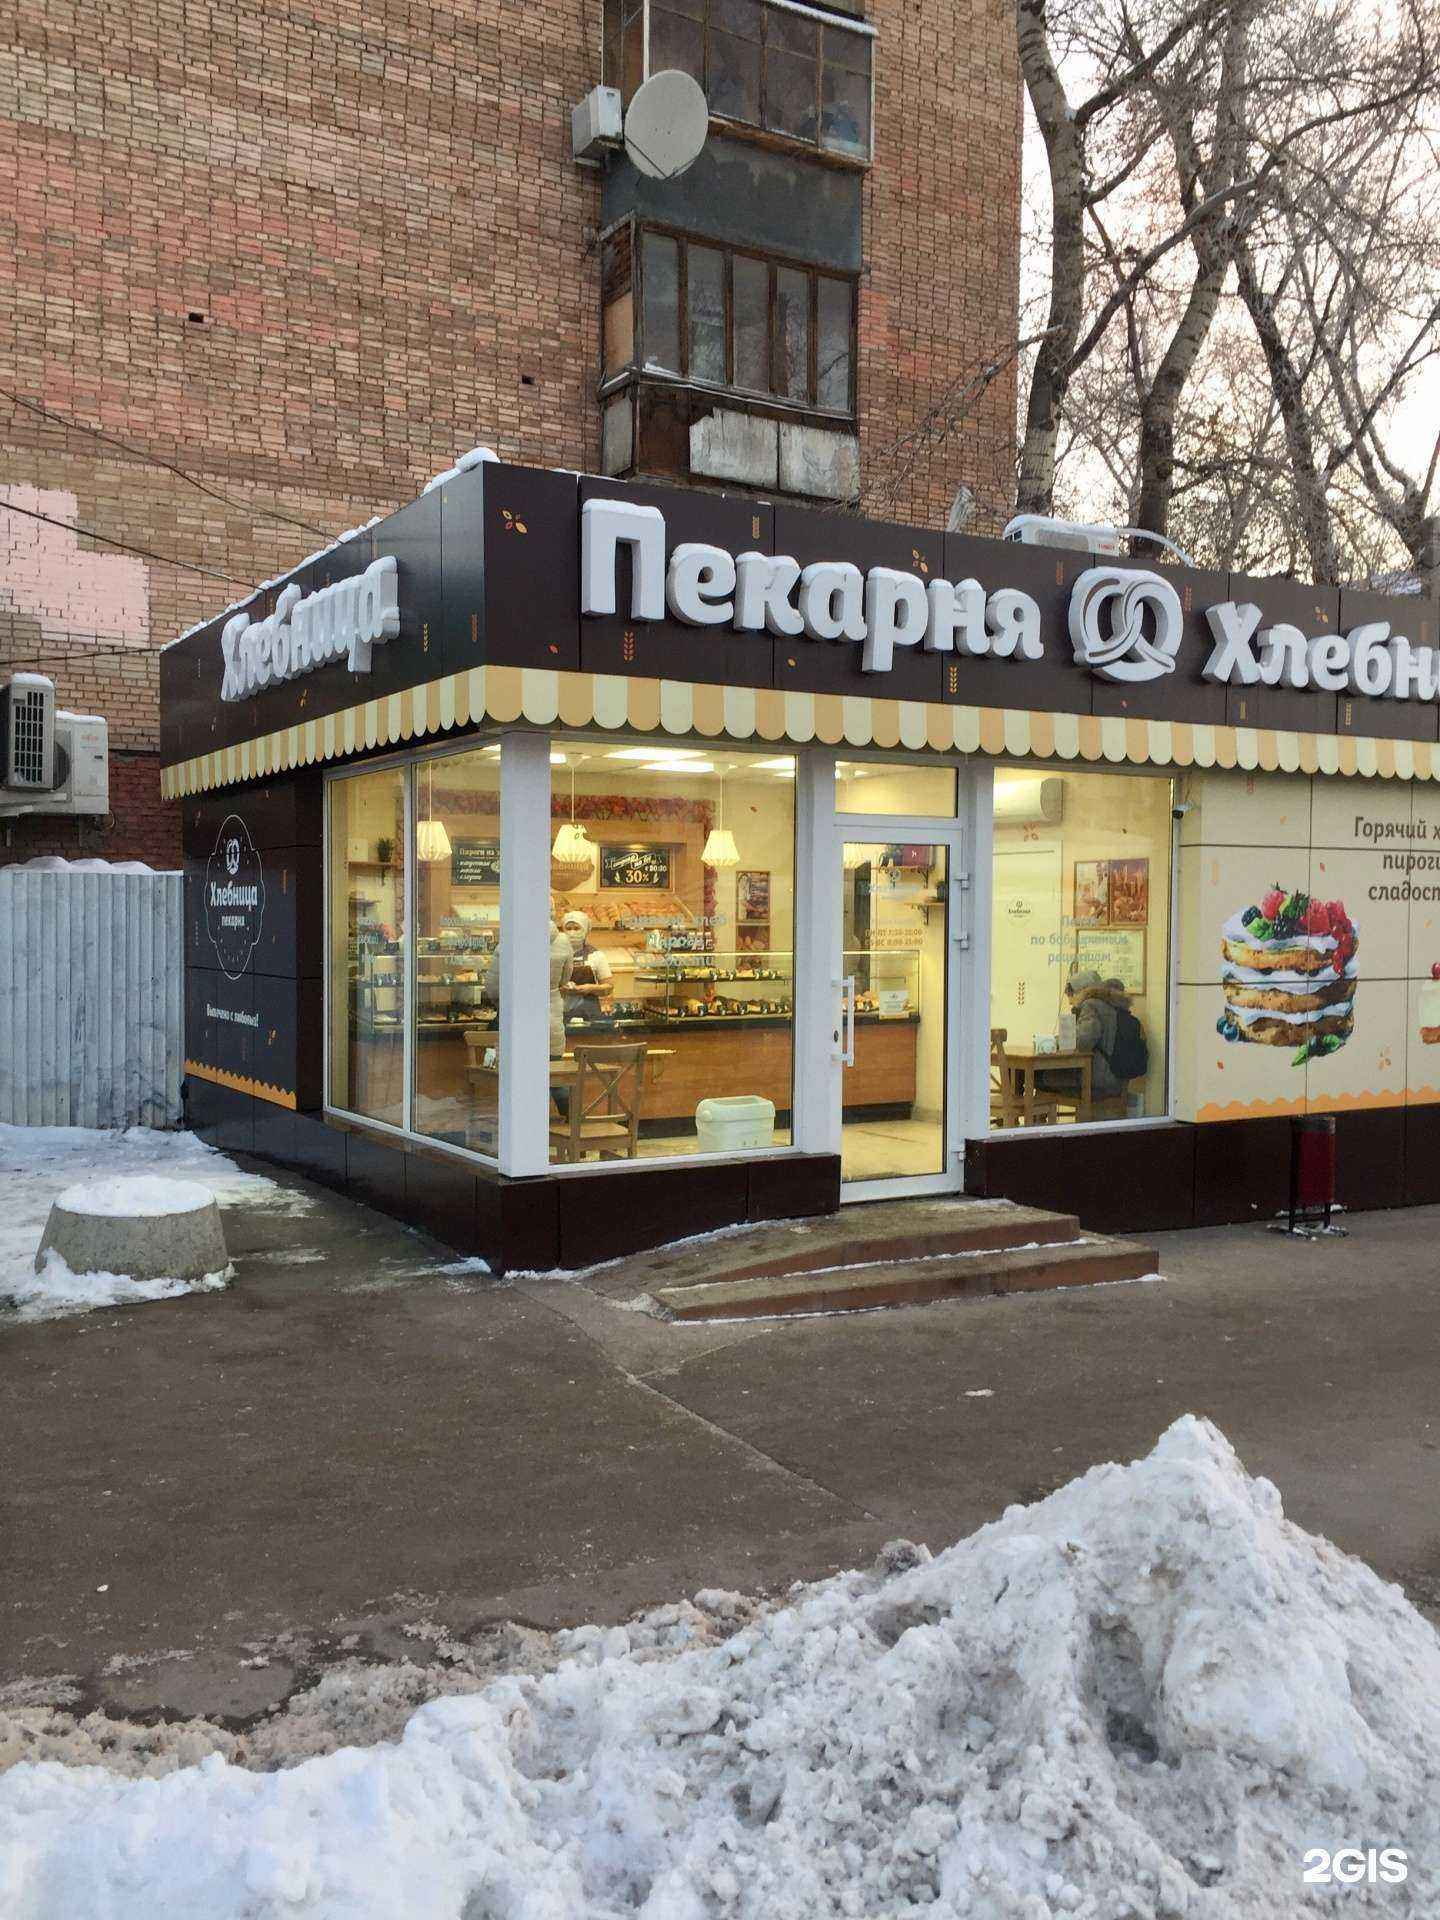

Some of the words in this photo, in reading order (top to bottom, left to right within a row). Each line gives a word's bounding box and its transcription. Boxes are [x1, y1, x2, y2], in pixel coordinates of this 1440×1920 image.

[582, 498, 1044, 672] Пекарня
[1202, 601, 1440, 701] Хлебн
[1354, 816, 1426, 843] Горячий
[625, 870, 649, 884] 30%
[210, 880, 257, 911] Хлебница
[1030, 934, 1045, 945] по
